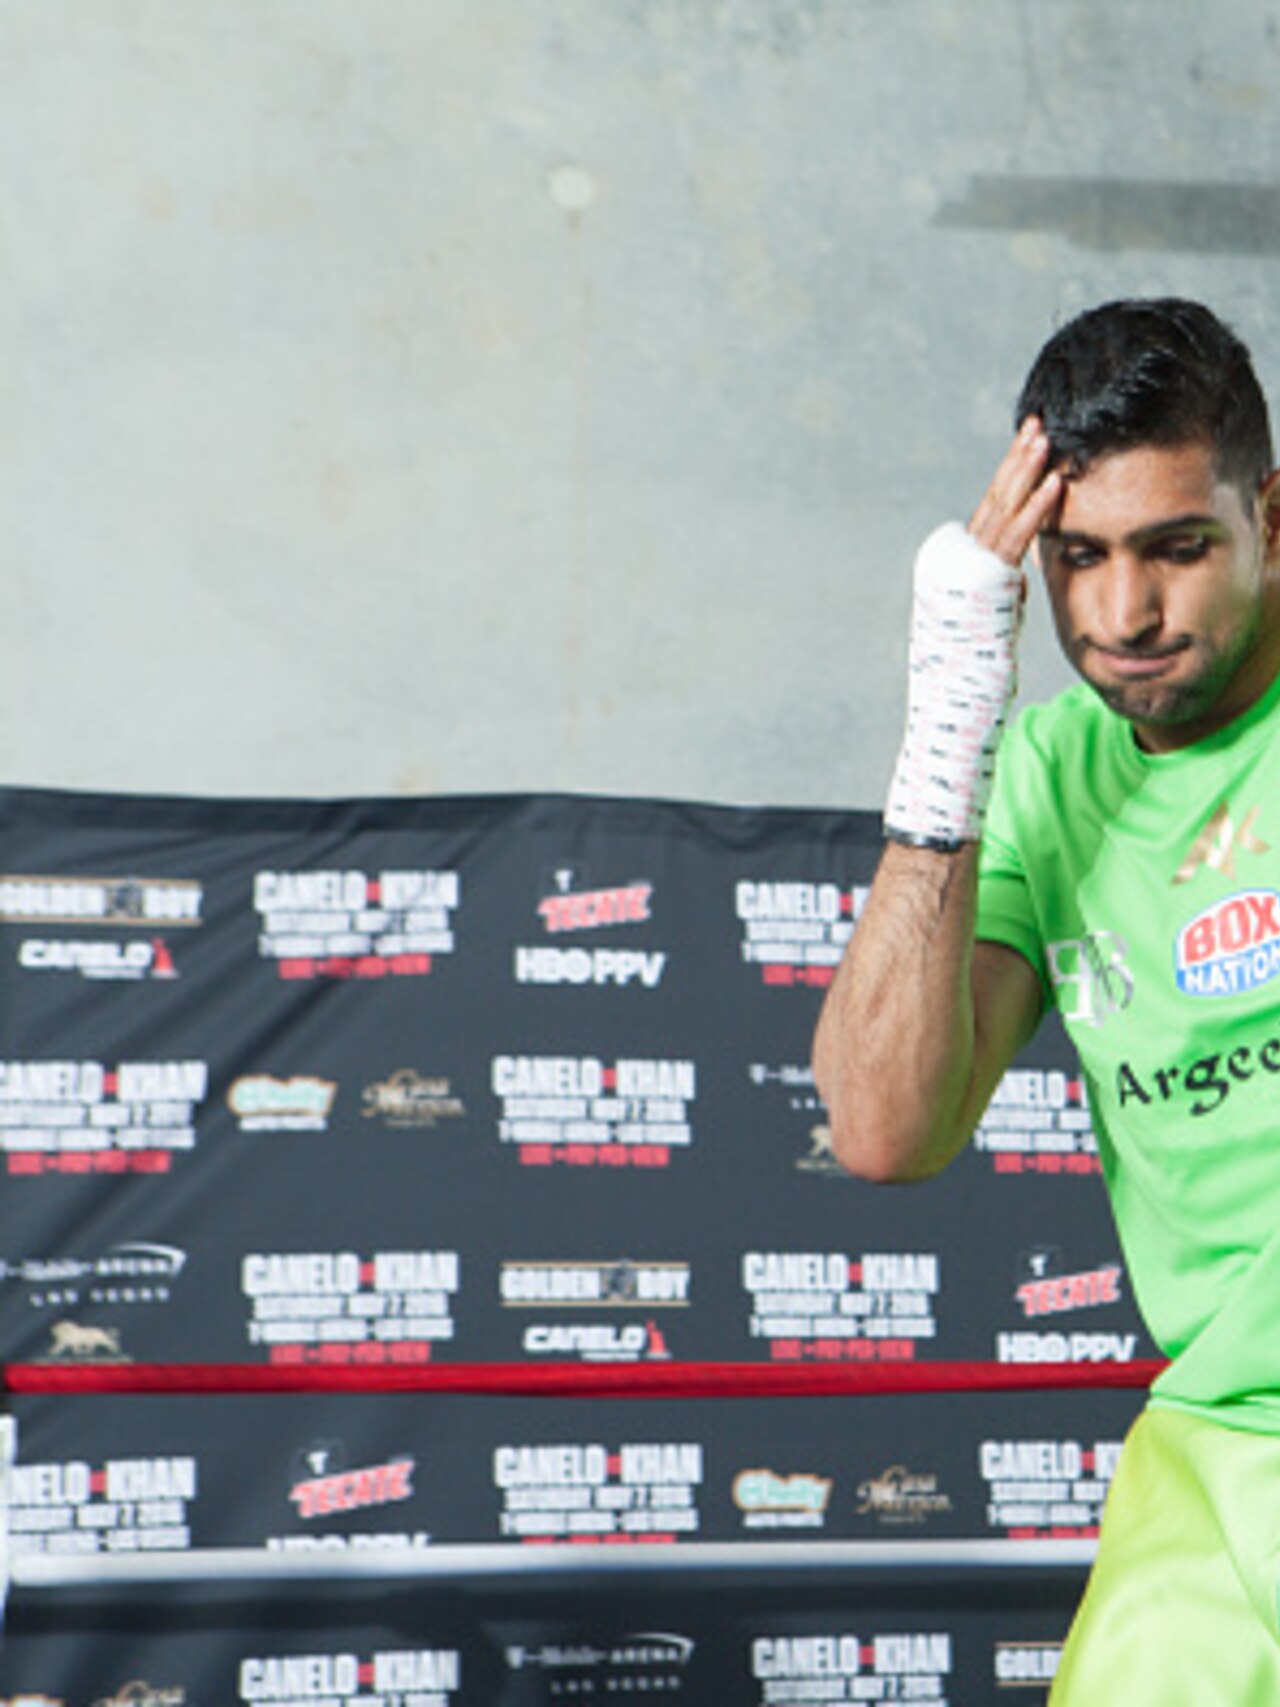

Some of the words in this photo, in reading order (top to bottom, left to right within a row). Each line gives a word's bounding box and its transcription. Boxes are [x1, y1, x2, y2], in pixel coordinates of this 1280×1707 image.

[538, 884, 652, 932] TECATE
[738, 882, 837, 920] CANELO
[1184, 896, 1280, 963] BOX
[593, 948, 665, 985] PPV
[0, 1062, 104, 1102] ANELO
[495, 1057, 600, 1096] CANELO
[617, 1060, 694, 1099] KHAN
[745, 1253, 847, 1290] CANELO
[862, 1254, 937, 1292] KHAN
[1016, 1265, 1121, 1317] TECATE
[999, 1331, 1068, 1363] HBO
[1069, 1332, 1137, 1363] PPV
[10, 1463, 89, 1505] NELO
[107, 1459, 194, 1501] KHAN
[496, 1447, 604, 1486] CANELO
[621, 1445, 701, 1483] KHAN
[982, 1443, 1080, 1479] CANELO
[289, 1459, 414, 1518] TECATE
[241, 1655, 356, 1699] CANELO
[373, 1650, 458, 1691] KHAN
[754, 1637, 857, 1677] CANELO
[874, 1635, 950, 1673] KHAN
